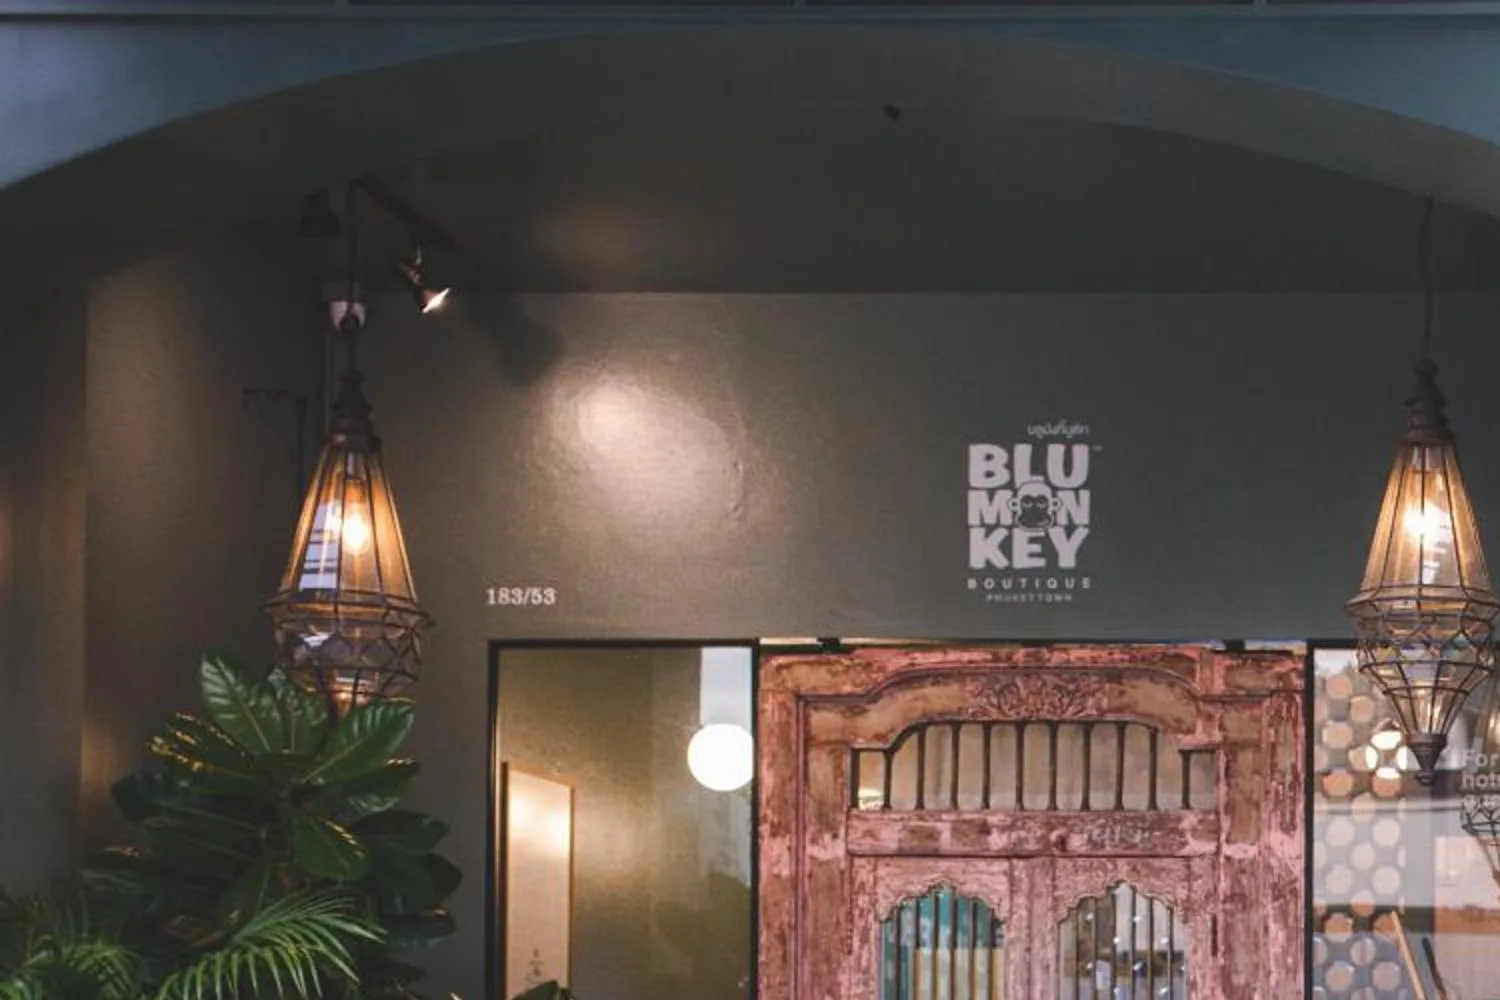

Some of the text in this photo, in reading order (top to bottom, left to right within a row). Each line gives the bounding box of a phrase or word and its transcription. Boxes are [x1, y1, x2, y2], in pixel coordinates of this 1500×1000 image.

[968, 443, 1089, 489] BLU
[968, 527, 1090, 569] KEY
[966, 577, 1091, 590] BOUTIQUE
[486, 587, 558, 606] 183/53
[1463, 748, 1500, 767] For
